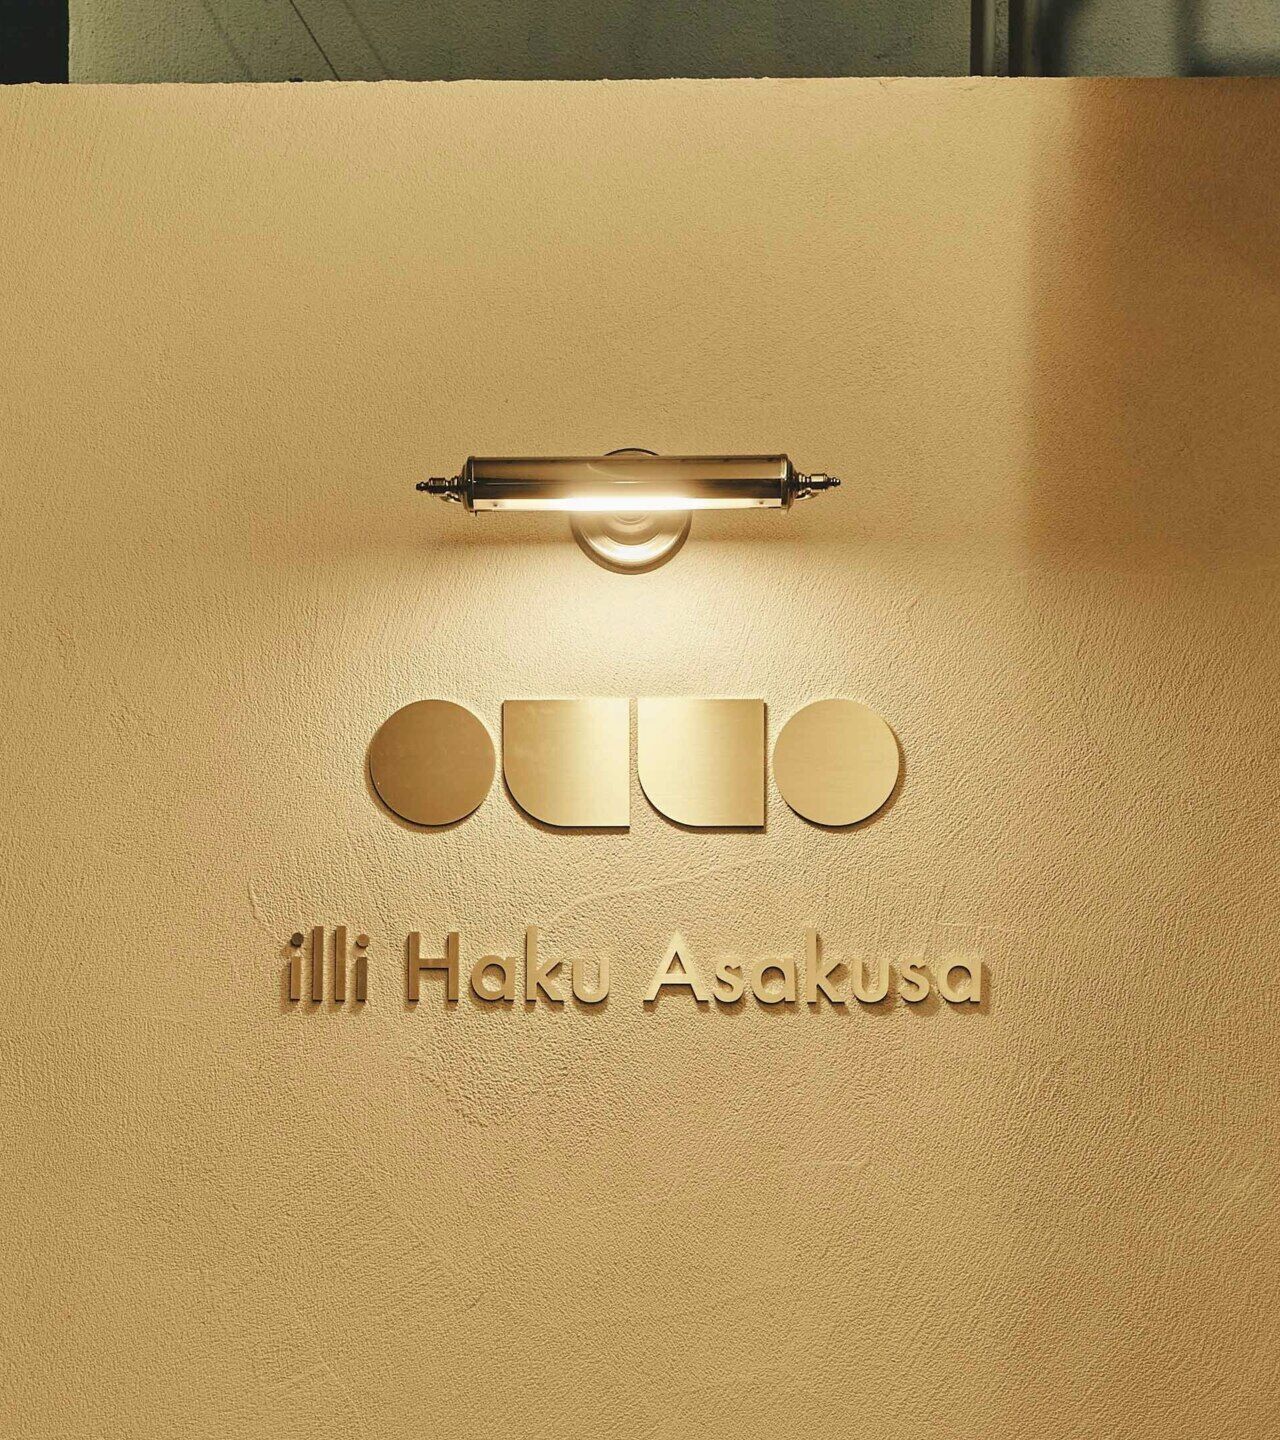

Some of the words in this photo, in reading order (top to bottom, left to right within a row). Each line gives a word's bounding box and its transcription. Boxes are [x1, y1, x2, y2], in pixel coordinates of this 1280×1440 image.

[289, 925, 369, 1002] illi
[407, 926, 610, 1004] Haku
[643, 928, 983, 1004] Asakusa
